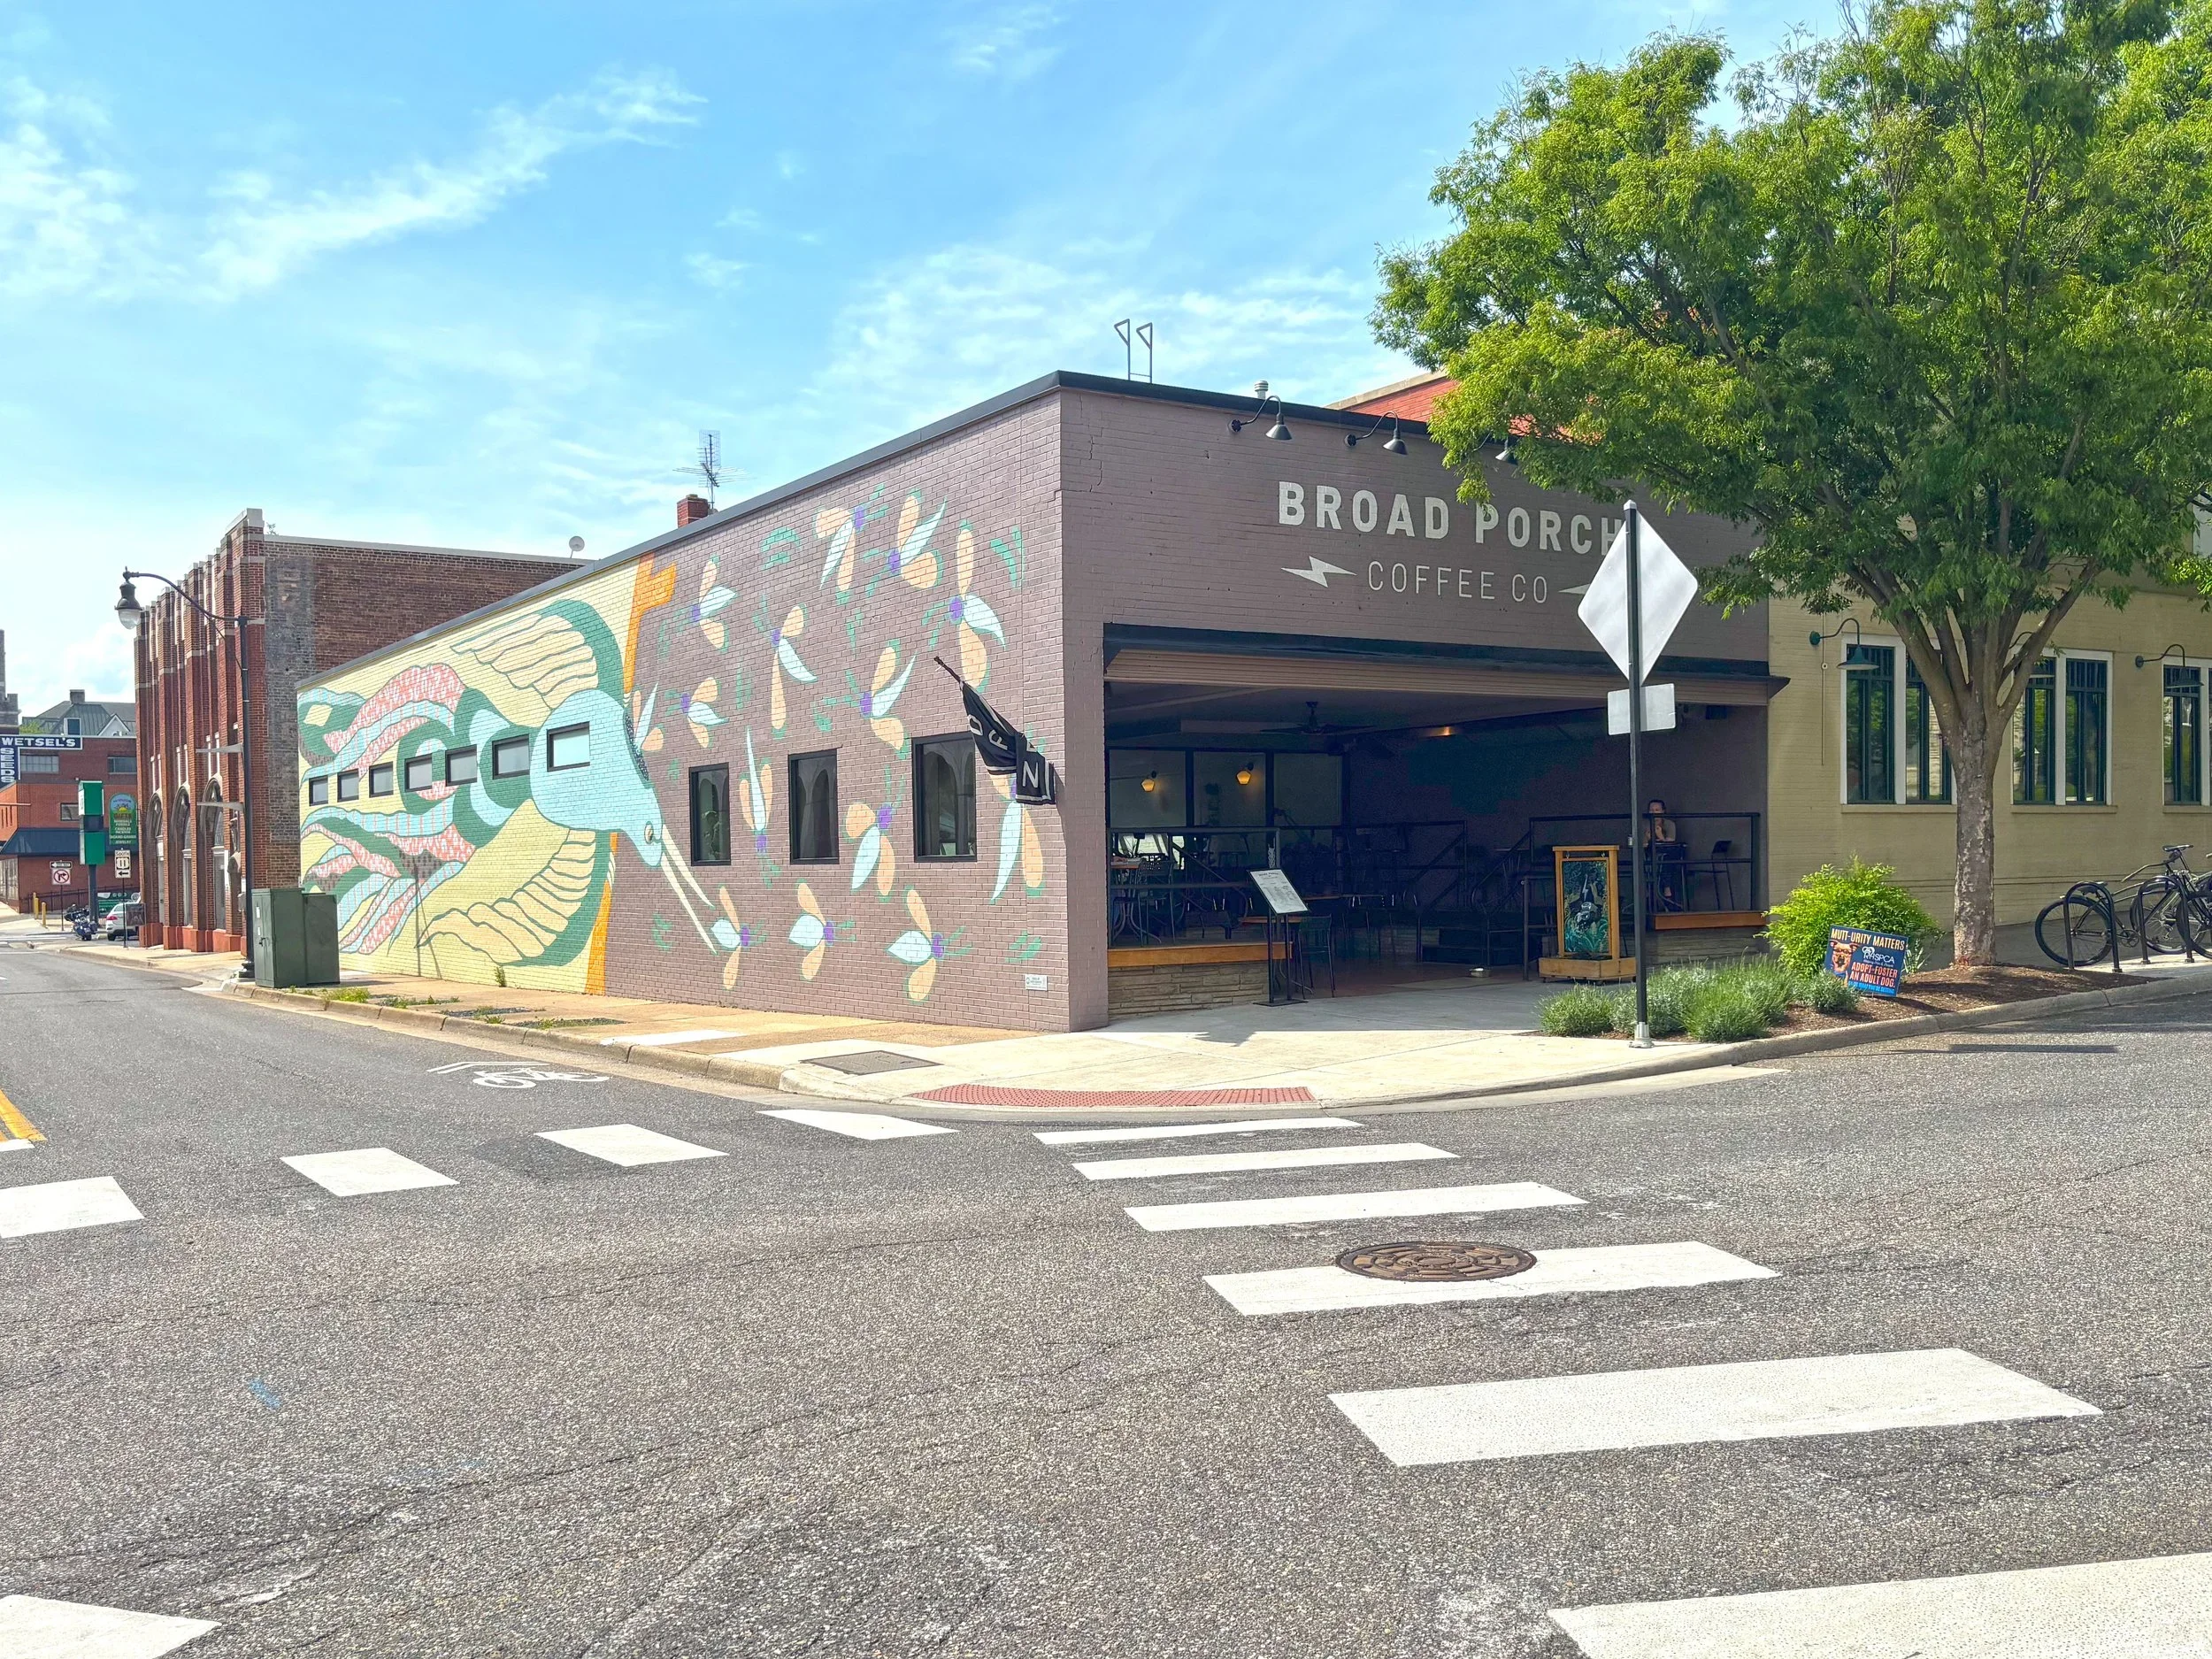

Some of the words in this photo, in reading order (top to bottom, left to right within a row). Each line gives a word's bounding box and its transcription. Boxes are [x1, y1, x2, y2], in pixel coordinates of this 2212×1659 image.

[1279, 481, 1449, 539] BROAD
[1475, 503, 1623, 556] PORCH
[1368, 561, 1495, 600] COFFEE
[1512, 573, 1548, 603] CO
[2, 737, 75, 747] WETSEL'S
[968, 714, 1039, 788] OPN
[0, 748, 15, 783] SEEDS
[1831, 928, 1871, 944] MUTT-URITY
[1872, 936, 1905, 951] MATTERS
[1849, 971, 1860, 980] AN
[1860, 972, 1880, 985] ADULT
[1881, 978, 1895, 988] DOG.
